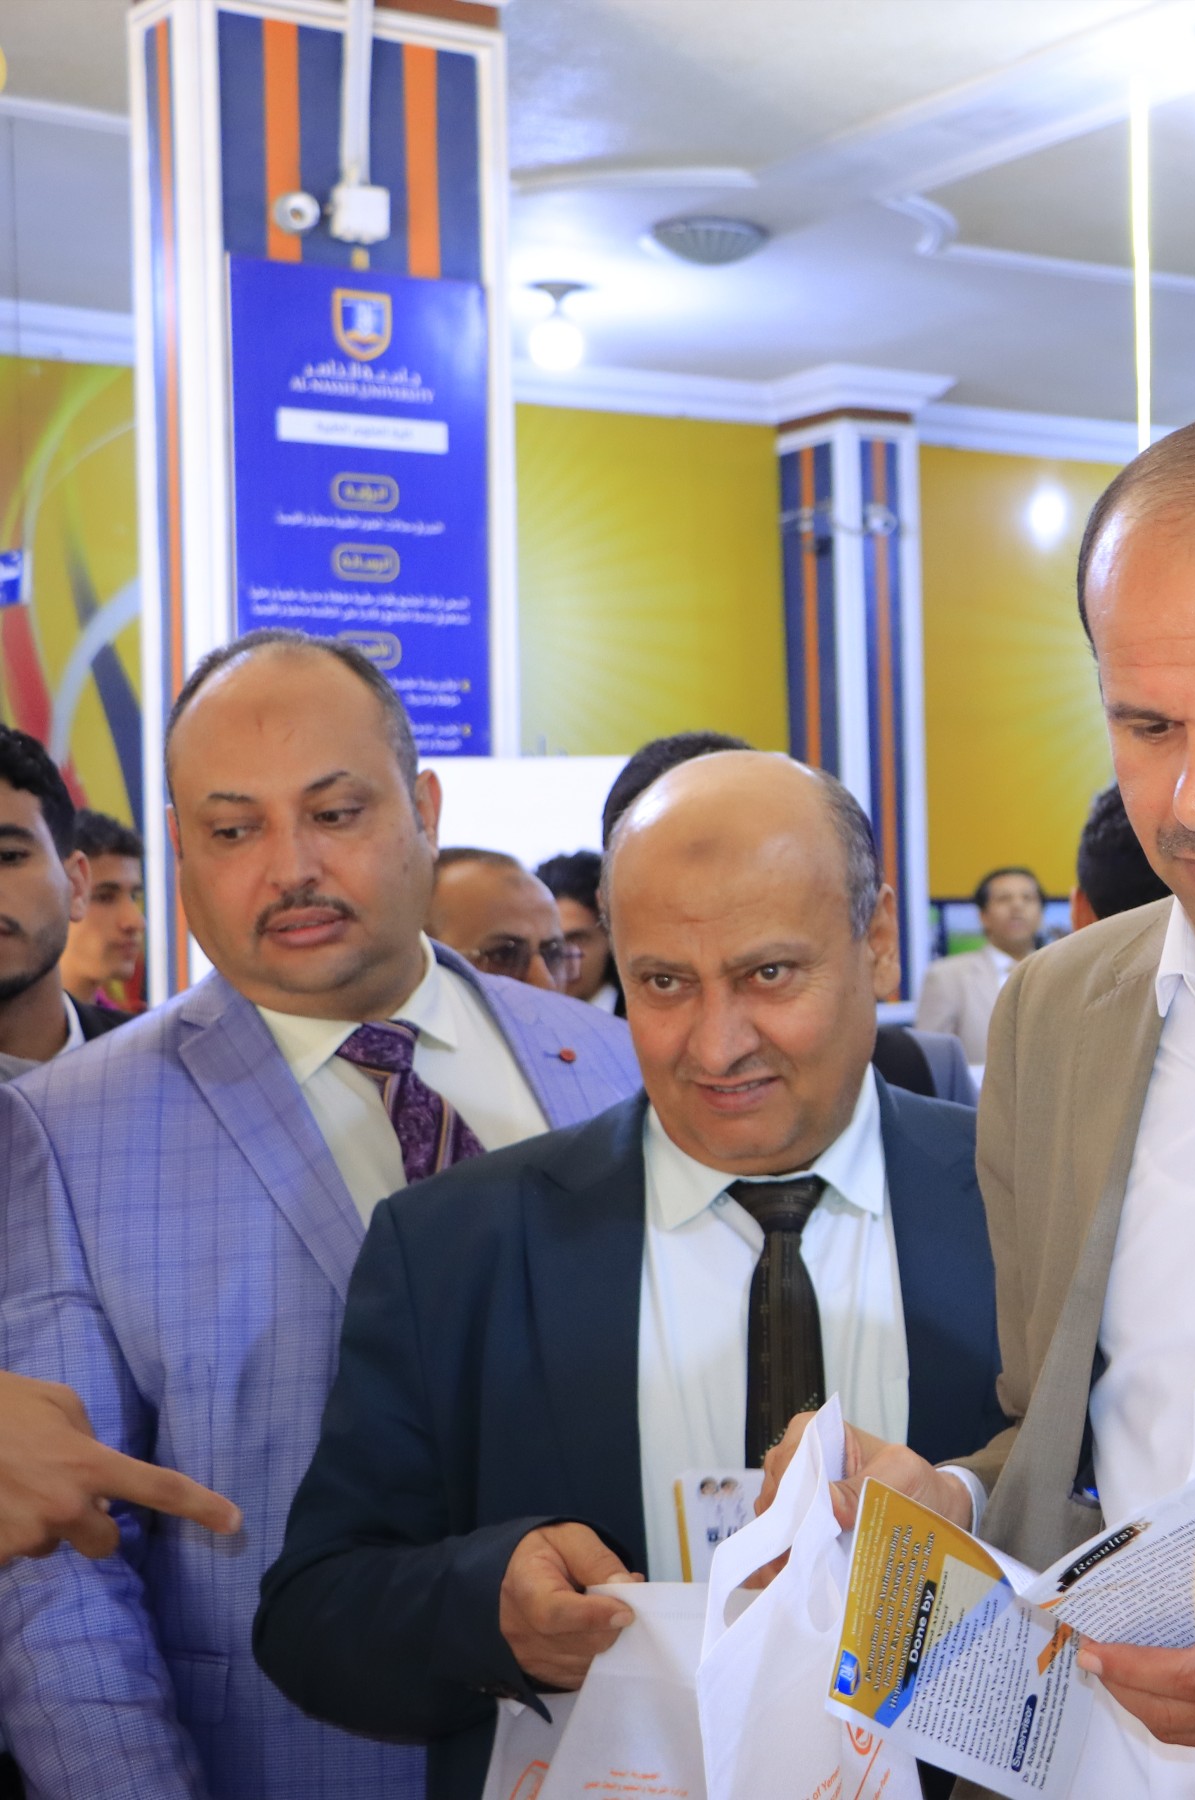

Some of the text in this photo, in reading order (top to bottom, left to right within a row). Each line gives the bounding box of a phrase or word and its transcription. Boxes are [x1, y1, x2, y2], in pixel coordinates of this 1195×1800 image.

[921, 1558, 928, 1572] on
[922, 1530, 934, 1556] Rats
[1071, 1529, 1134, 1574] Results:
[1157, 1552, 1181, 1566] pollen
[872, 1523, 912, 1691] Antioxidant and Toxicity of Bee
[882, 1541, 920, 1687] Pollen Extract and study its
[906, 1572, 925, 1628] Protection
[908, 1586, 935, 1665] Done by
[863, 1623, 880, 1682] Evaluation
[874, 1603, 883, 1621] the
[1011, 1703, 1034, 1769] Supervisor
[1026, 1714, 1044, 1766] Abdulkarim
